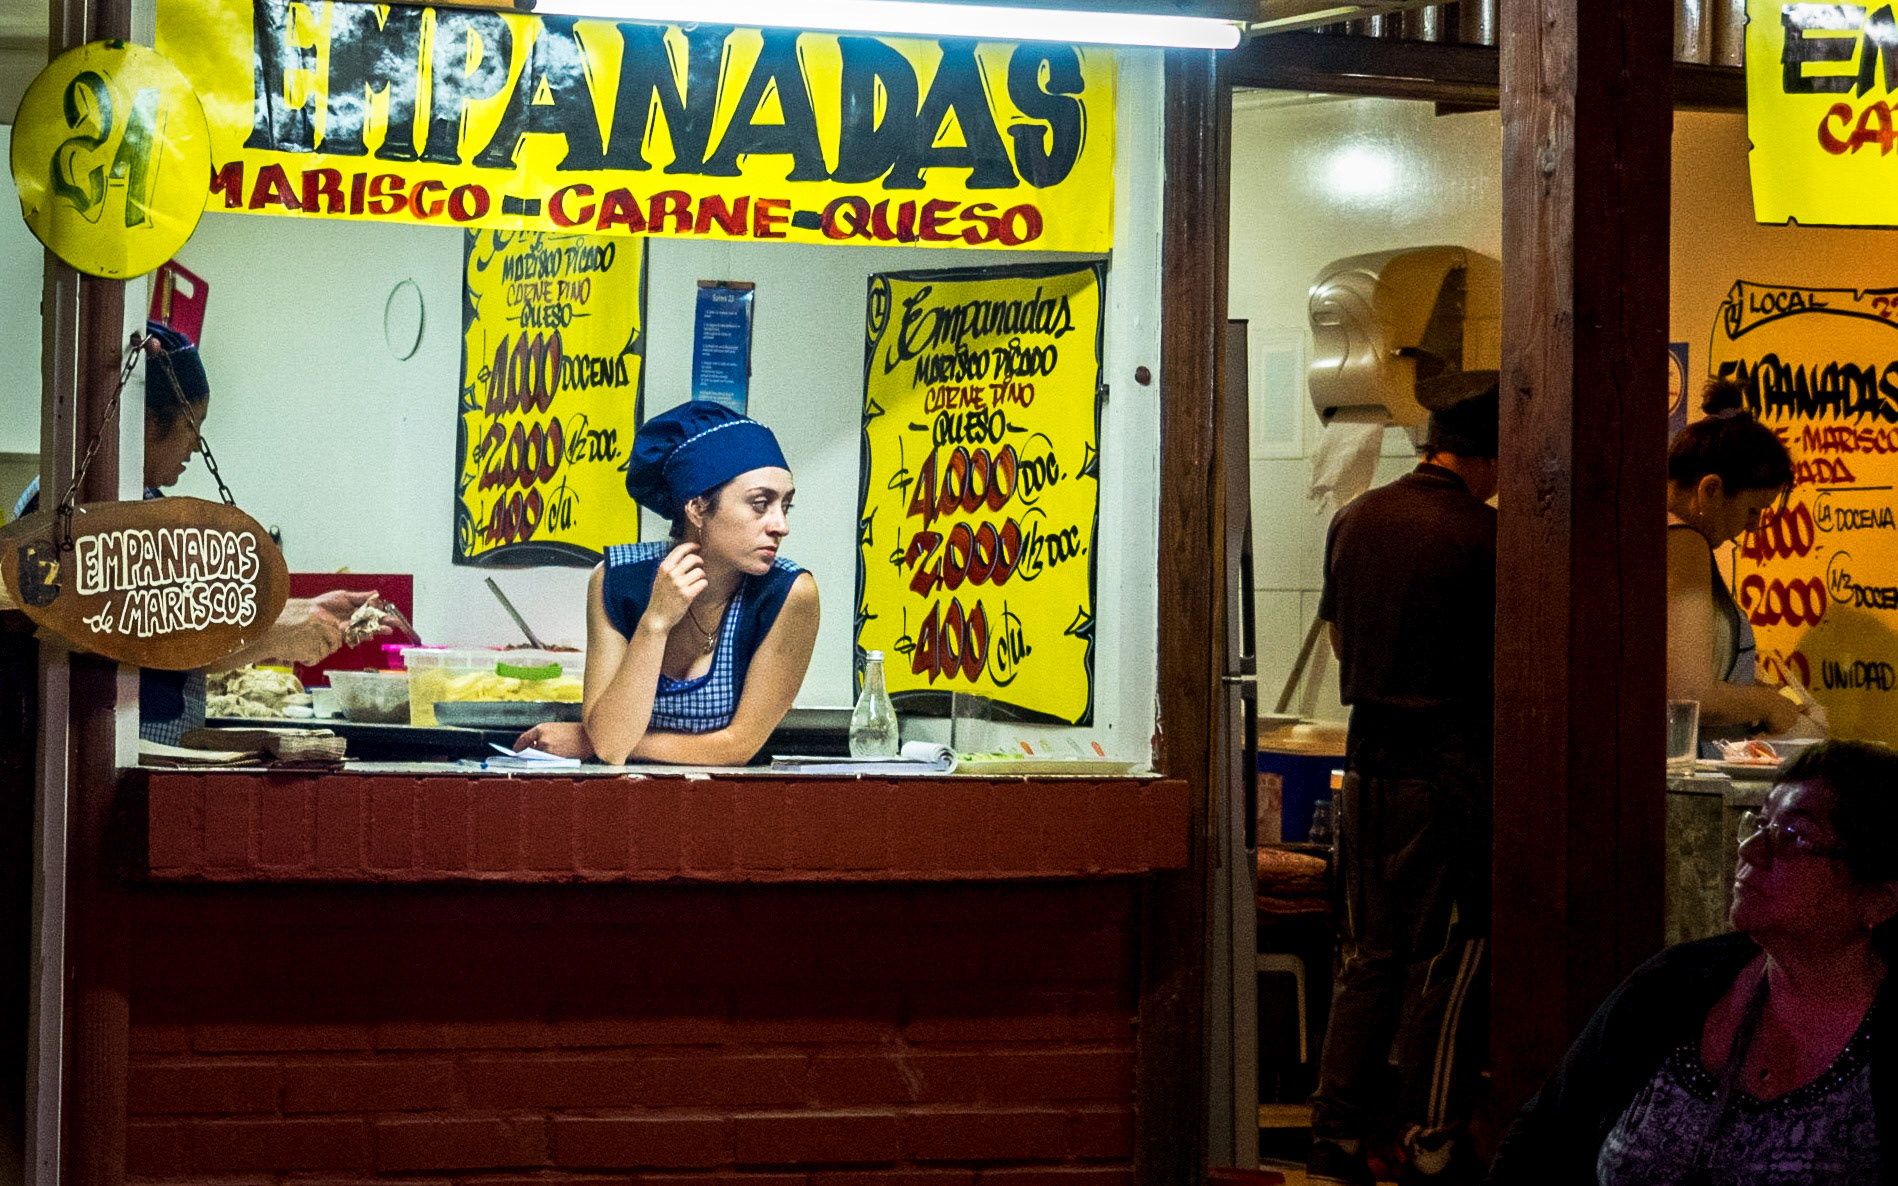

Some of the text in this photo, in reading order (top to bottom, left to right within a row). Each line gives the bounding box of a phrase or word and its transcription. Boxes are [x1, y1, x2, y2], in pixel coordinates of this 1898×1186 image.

[209, 160, 1043, 246] MARISCO CARNE QUESO
[506, 279, 554, 307] CARNE
[1750, 292, 1829, 315] LOCAL
[519, 303, 573, 329] QUESO
[885, 286, 1075, 375] Empanadas
[912, 344, 990, 390] MARISCO
[924, 385, 987, 415] CARNE
[932, 408, 1006, 450] QUESO
[1836, 508, 1896, 532] DOCENA
[75, 528, 259, 595] EMPANADAS
[83, 582, 257, 637] de MARISCOS
[1822, 658, 1896, 691] UNIDAD
